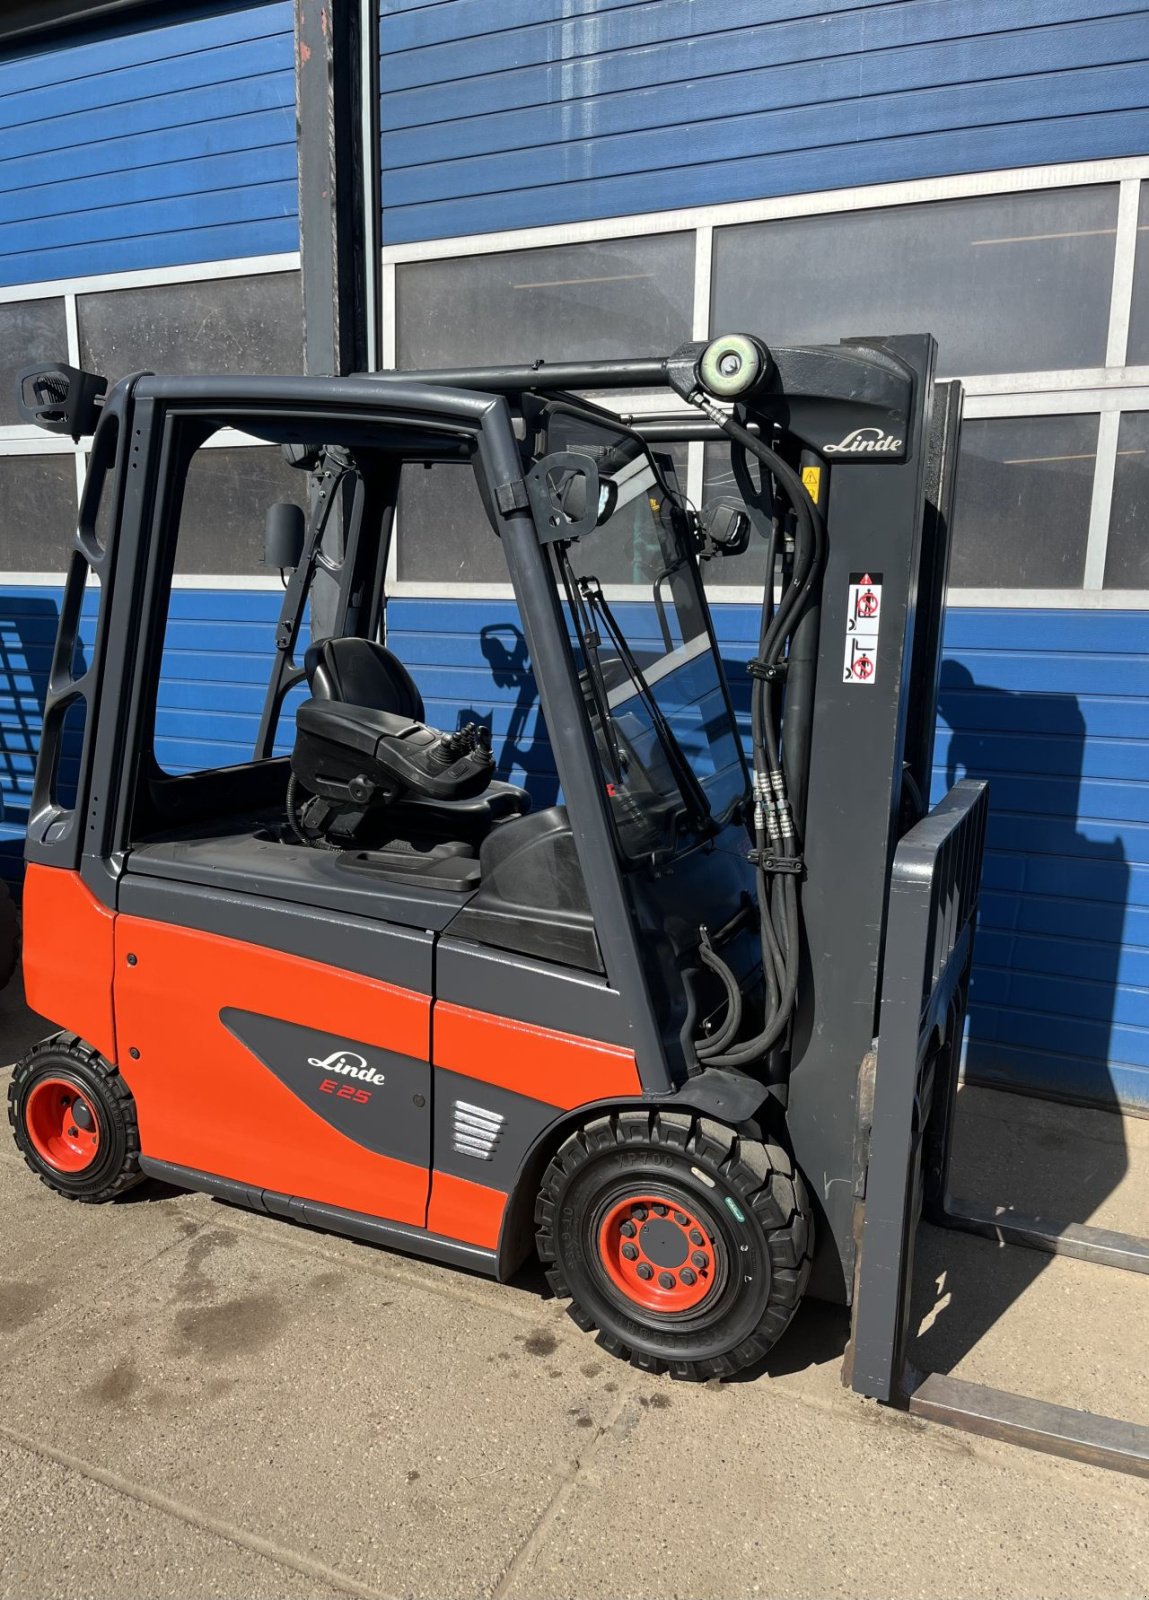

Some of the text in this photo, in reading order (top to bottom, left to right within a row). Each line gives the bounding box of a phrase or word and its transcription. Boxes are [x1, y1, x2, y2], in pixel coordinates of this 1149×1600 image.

[822, 427, 902, 453] Linde
[307, 1051, 385, 1086] Linde
[319, 1079, 372, 1104] E 25
